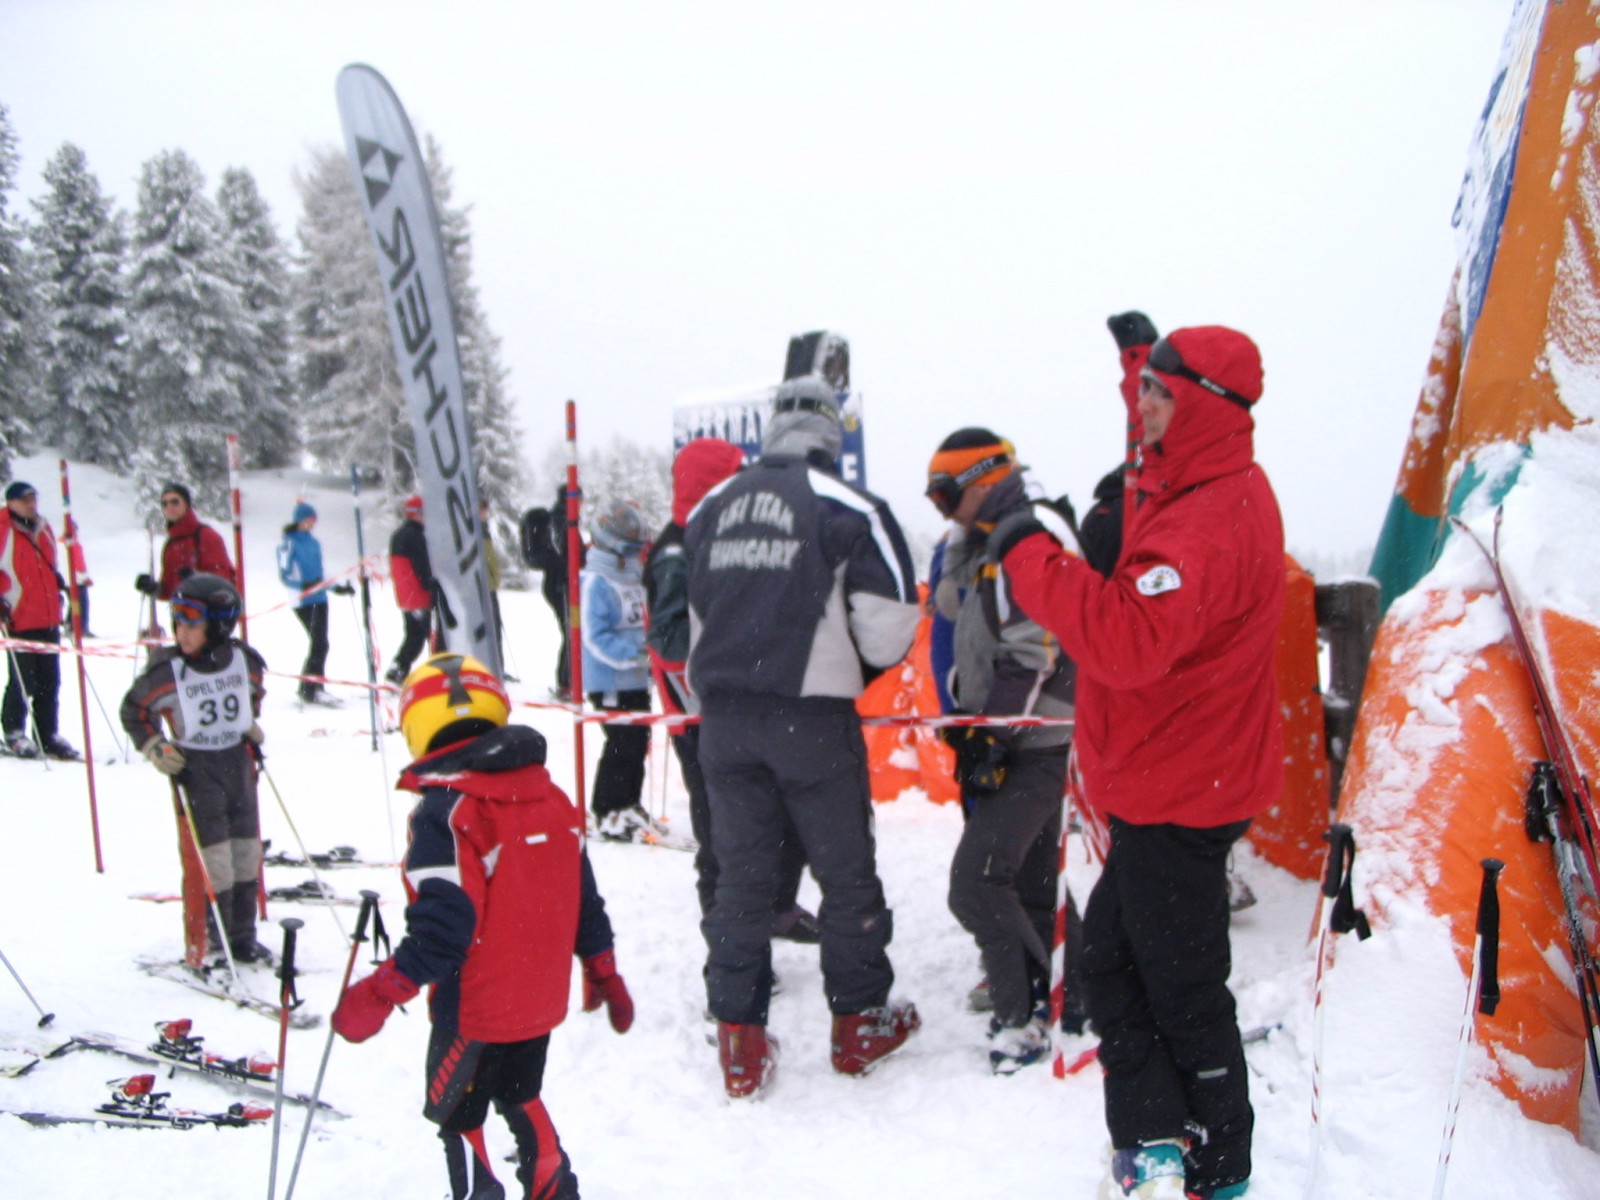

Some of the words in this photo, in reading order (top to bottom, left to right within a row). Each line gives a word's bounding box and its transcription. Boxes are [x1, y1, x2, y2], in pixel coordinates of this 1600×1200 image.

[954, 456, 995, 485] SCOTT
[708, 539, 800, 570] HUNGARY
[185, 682, 214, 699] OPEL
[198, 693, 240, 726] 39
